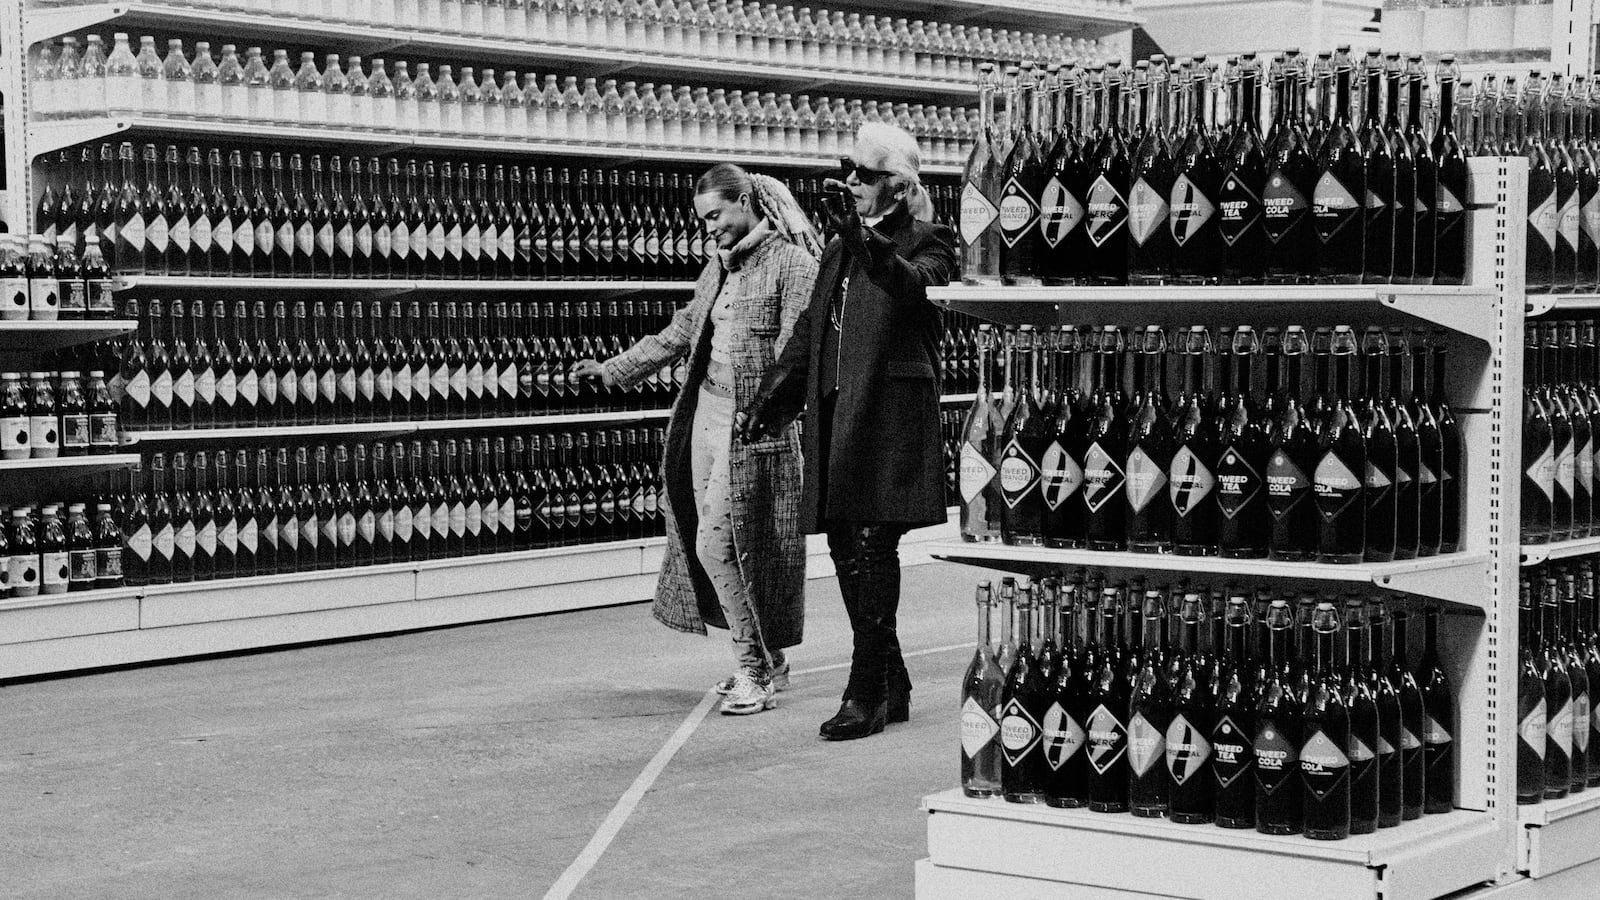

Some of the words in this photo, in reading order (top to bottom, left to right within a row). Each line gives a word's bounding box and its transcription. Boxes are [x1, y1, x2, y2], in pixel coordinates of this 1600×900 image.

[1220, 201, 1248, 209] TWEED
[1263, 197, 1294, 206] TWEED
[1224, 209, 1240, 217] TEA
[1265, 206, 1290, 214] COLA
[1218, 475, 1248, 484] TWEED
[1267, 475, 1297, 485] TWEED
[1222, 482, 1240, 490] TEA
[1268, 484, 1292, 492] COLA
[1213, 742, 1243, 753] TWEED
[1218, 751, 1236, 760] TEA
[1255, 749, 1287, 759] TWEED
[1257, 757, 1283, 767] COLA
[1301, 762, 1323, 771] COLA
